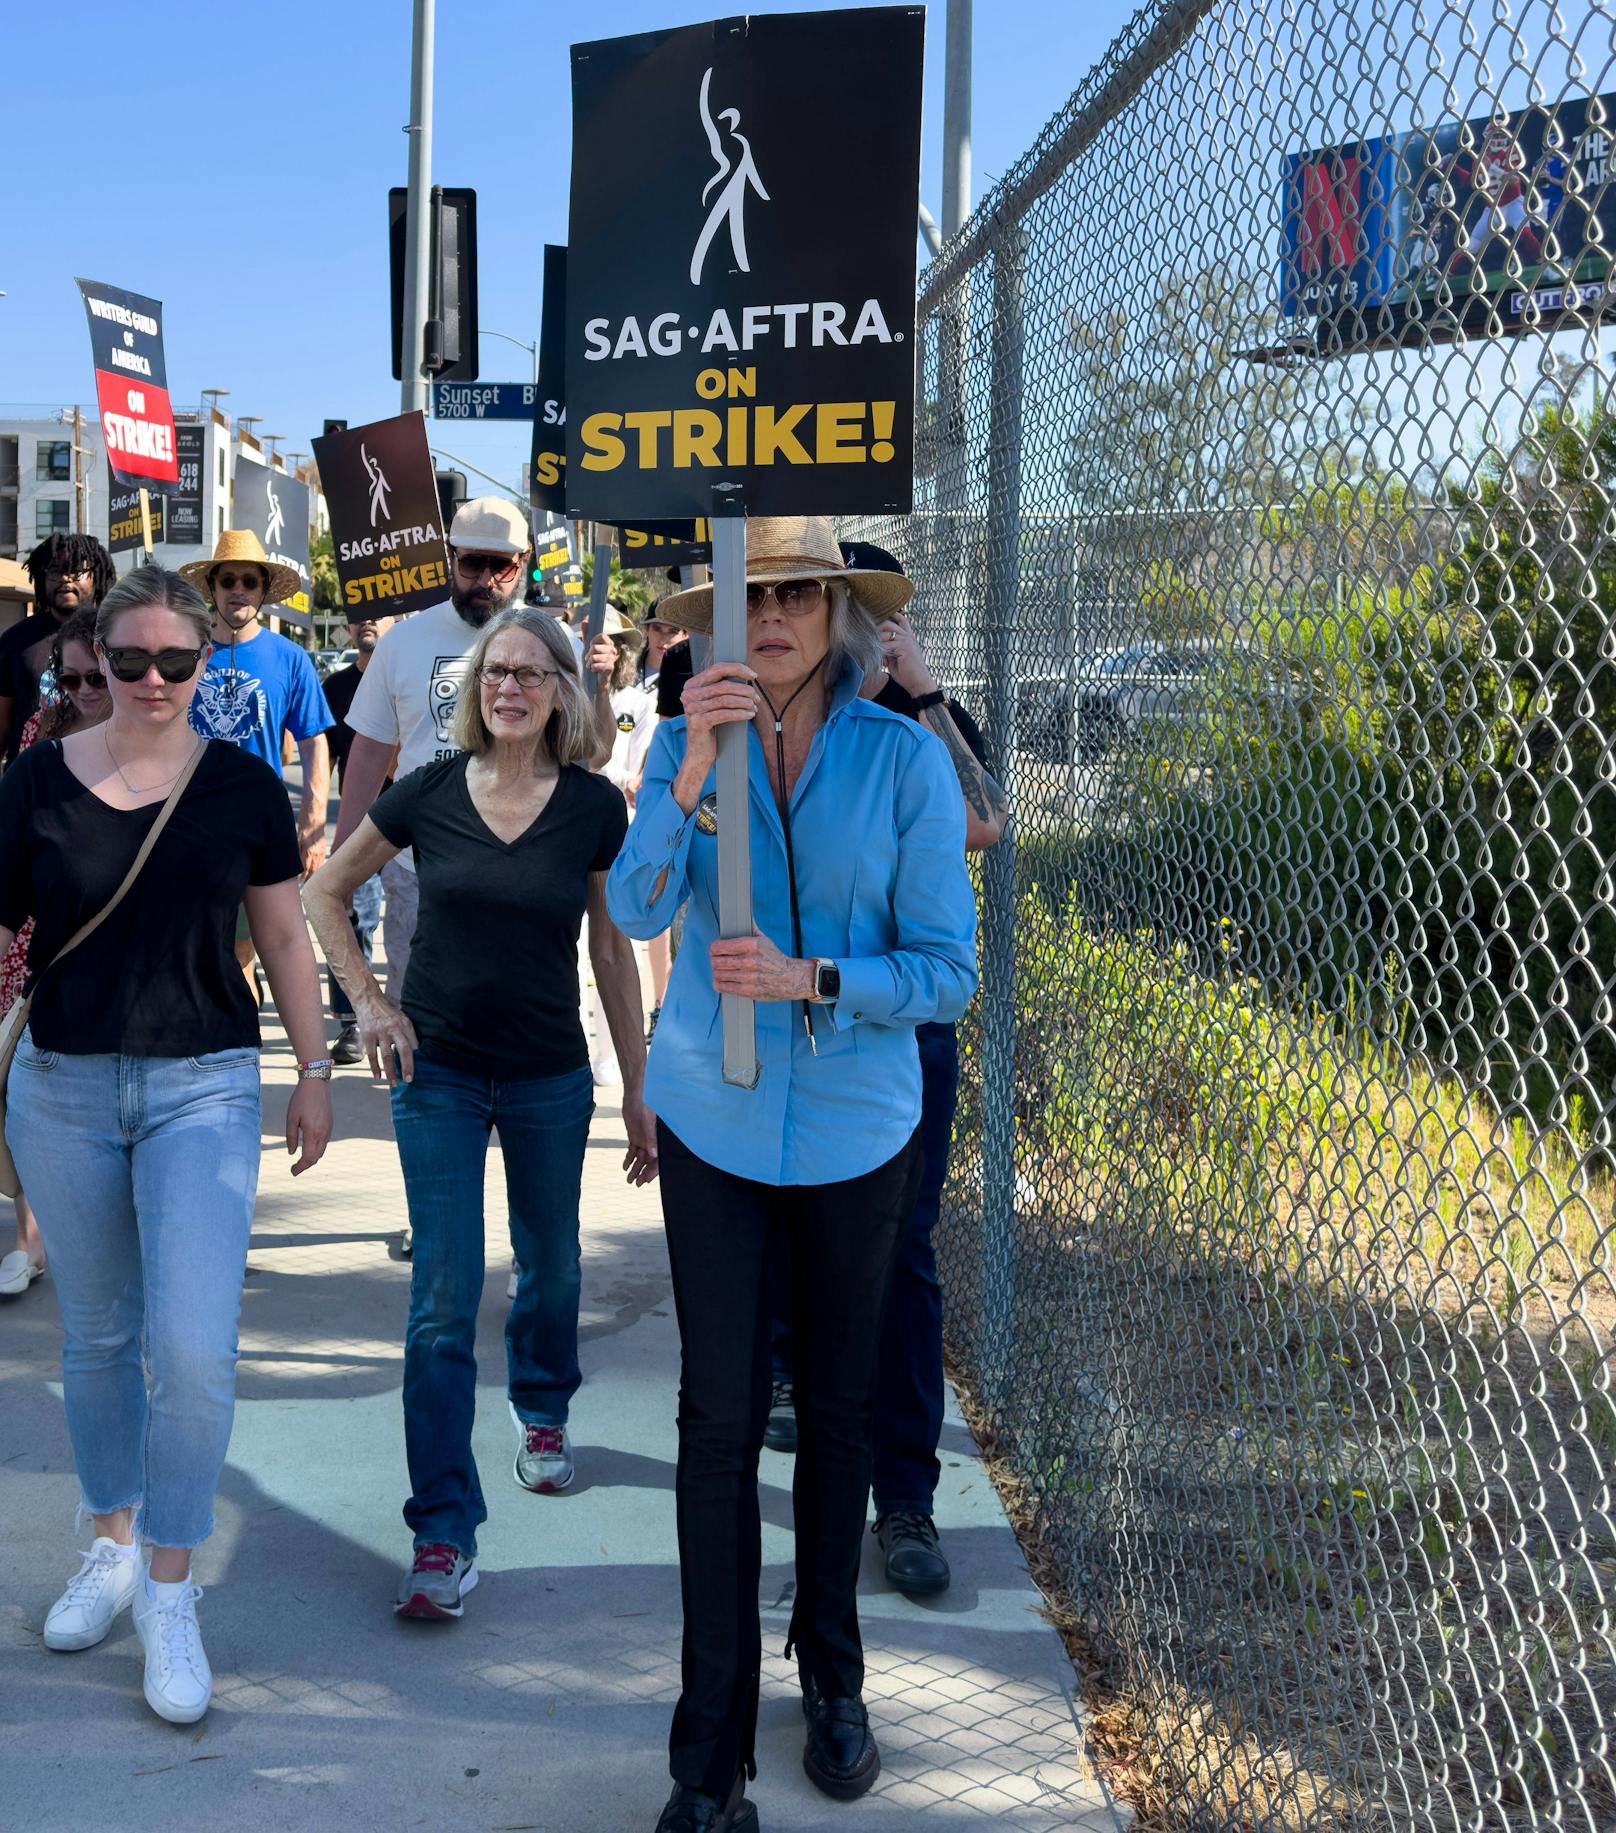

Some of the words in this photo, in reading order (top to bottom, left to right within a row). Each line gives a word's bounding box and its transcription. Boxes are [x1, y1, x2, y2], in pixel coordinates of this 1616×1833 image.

[1303, 283, 1338, 301] JUY
[88, 297, 132, 327] WRITERS
[131, 312, 158, 336] GUILD
[123, 331, 134, 347] OF
[112, 348, 152, 376] AMERICA
[695, 366, 757, 400] ON
[127, 390, 145, 414] ON
[439, 384, 500, 405] Sunset
[522, 385, 537, 405] B
[438, 404, 469, 418] 5700
[475, 404, 485, 418] W
[103, 411, 173, 463] STRIKE!
[580, 401, 896, 472] STRIKE!
[128, 507, 140, 518] ON
[379, 554, 401, 571] ON
[344, 560, 447, 605] STRIKE!
[236, 671, 252, 680] OF
